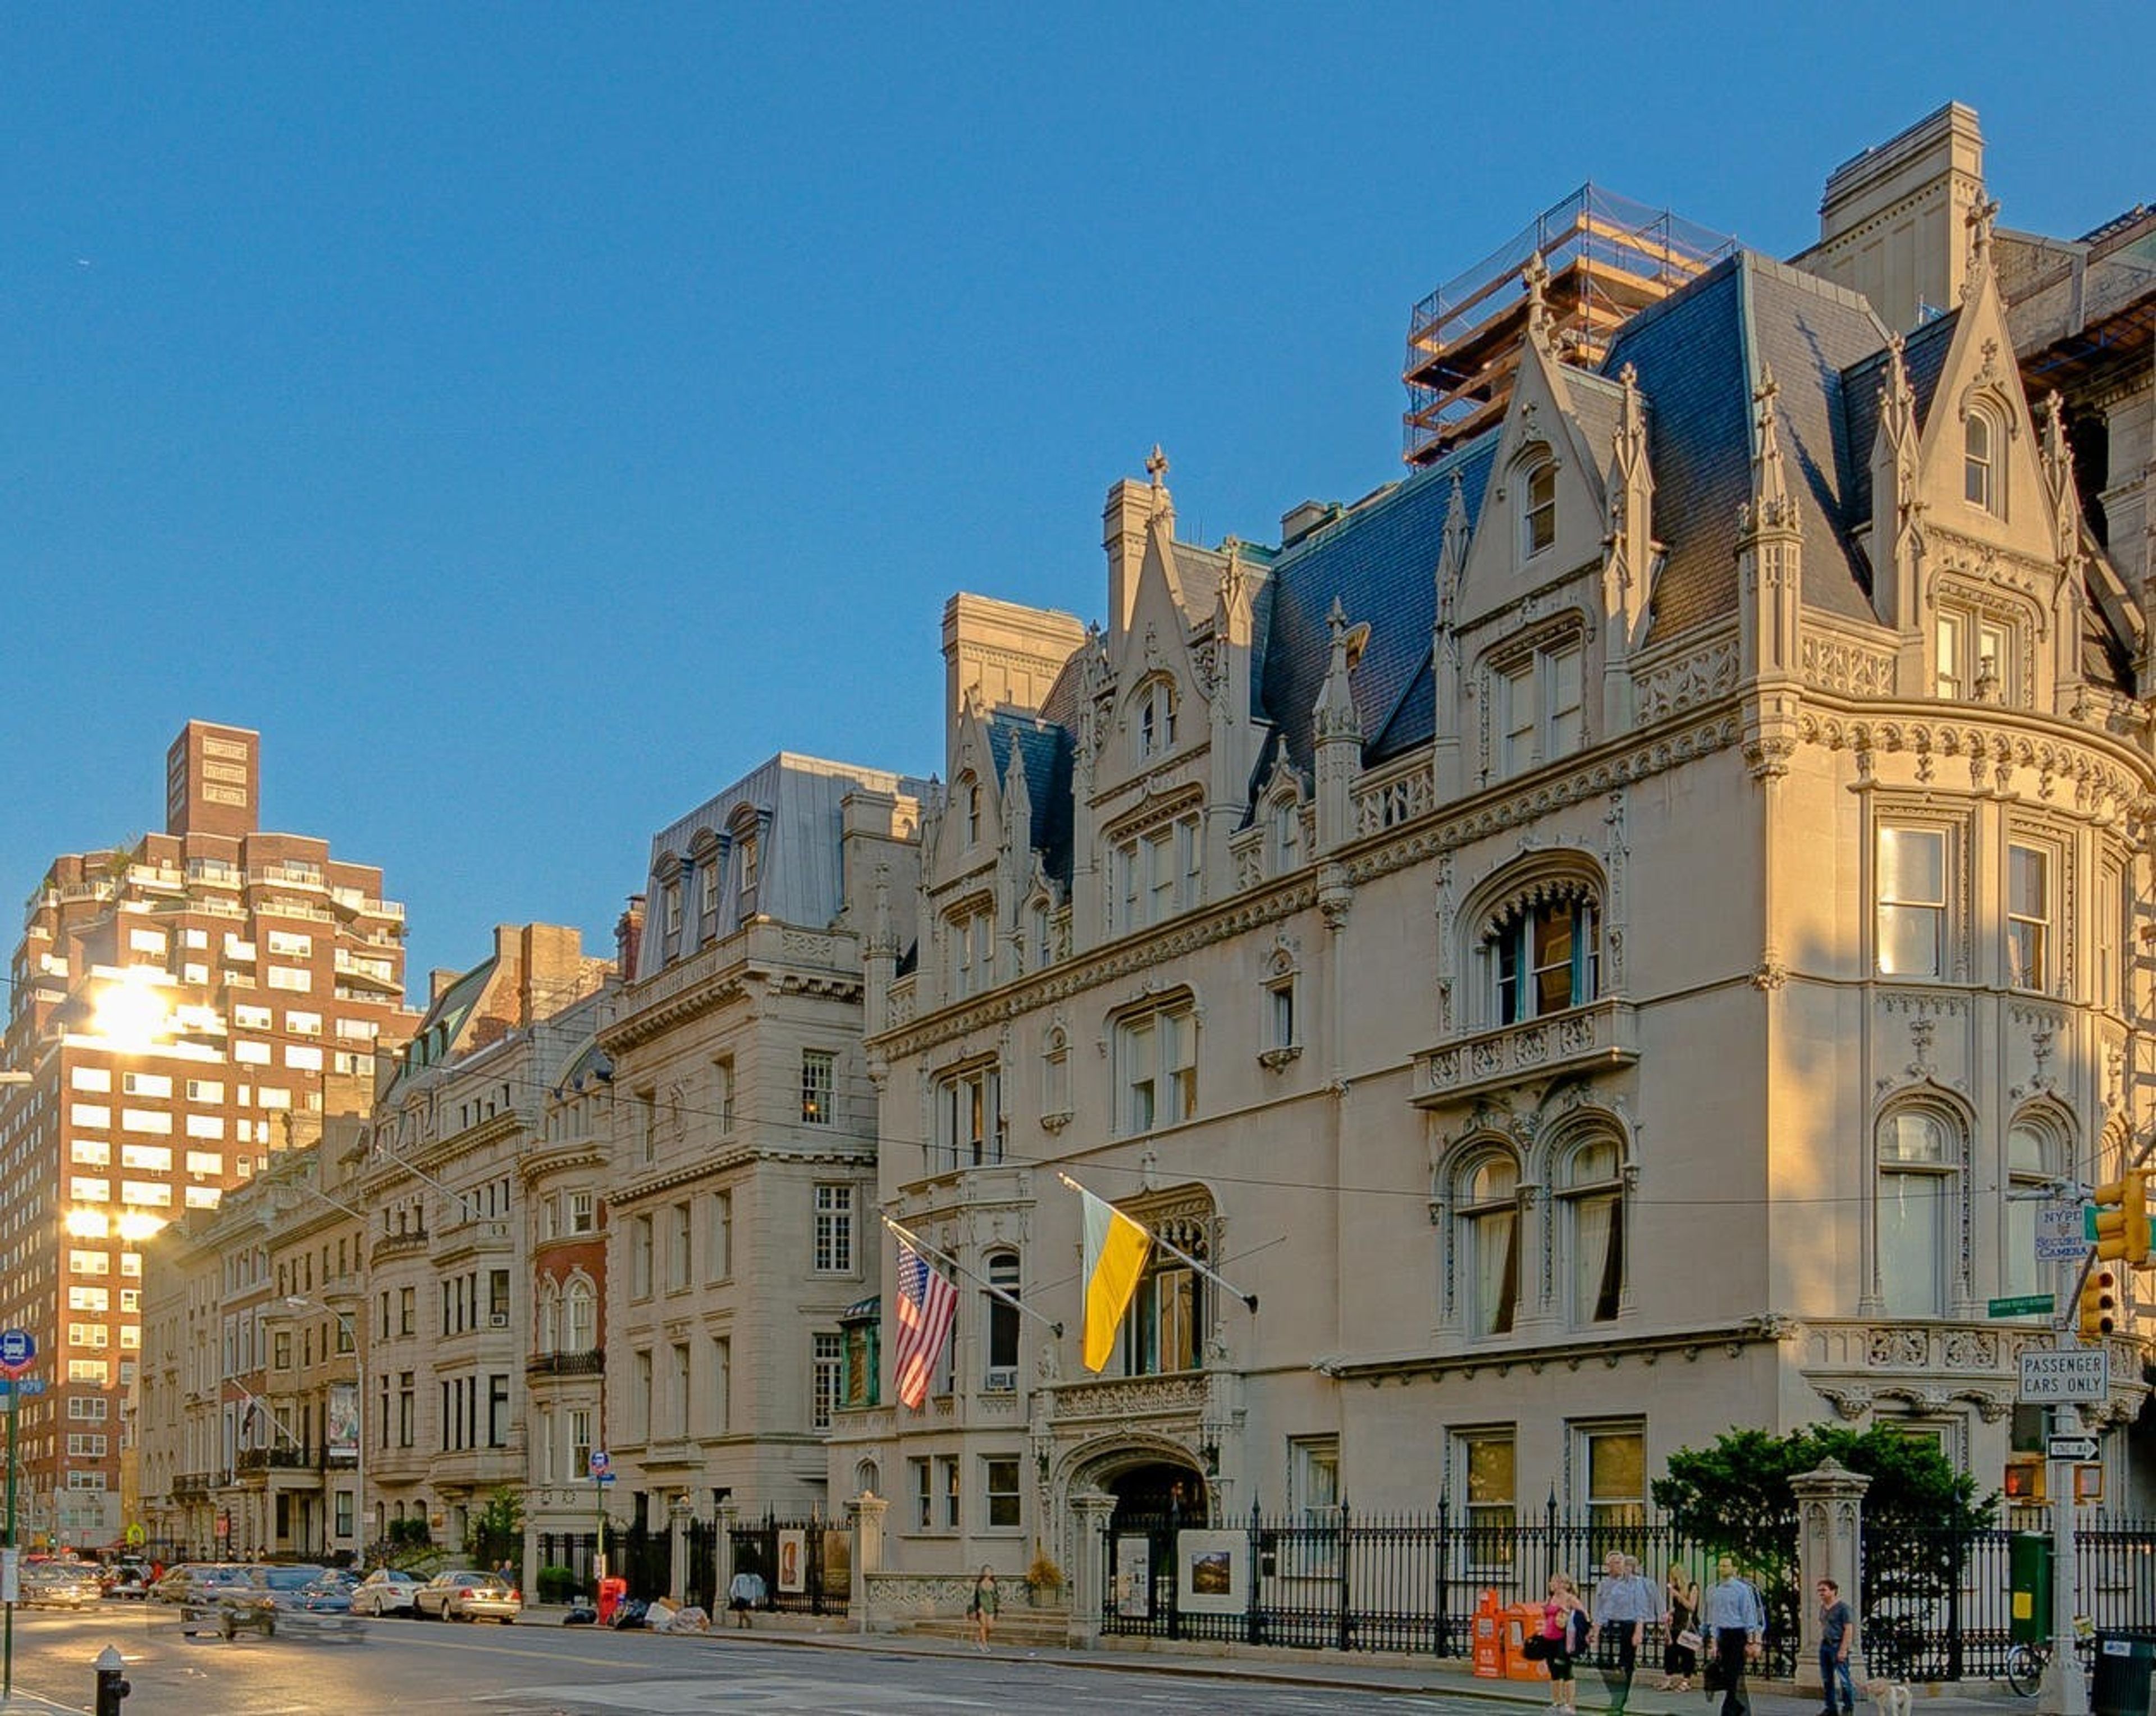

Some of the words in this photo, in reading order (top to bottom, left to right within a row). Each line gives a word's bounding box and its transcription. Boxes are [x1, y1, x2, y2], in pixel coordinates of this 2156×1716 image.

[2044, 1211, 2082, 1223] NYPD
[2036, 1236, 2081, 1248] SECURIT
[2025, 1358, 2100, 1373] PASSENGER
[2025, 1379, 2059, 1393] CARS
[2068, 1377, 2101, 1392] ONLY
